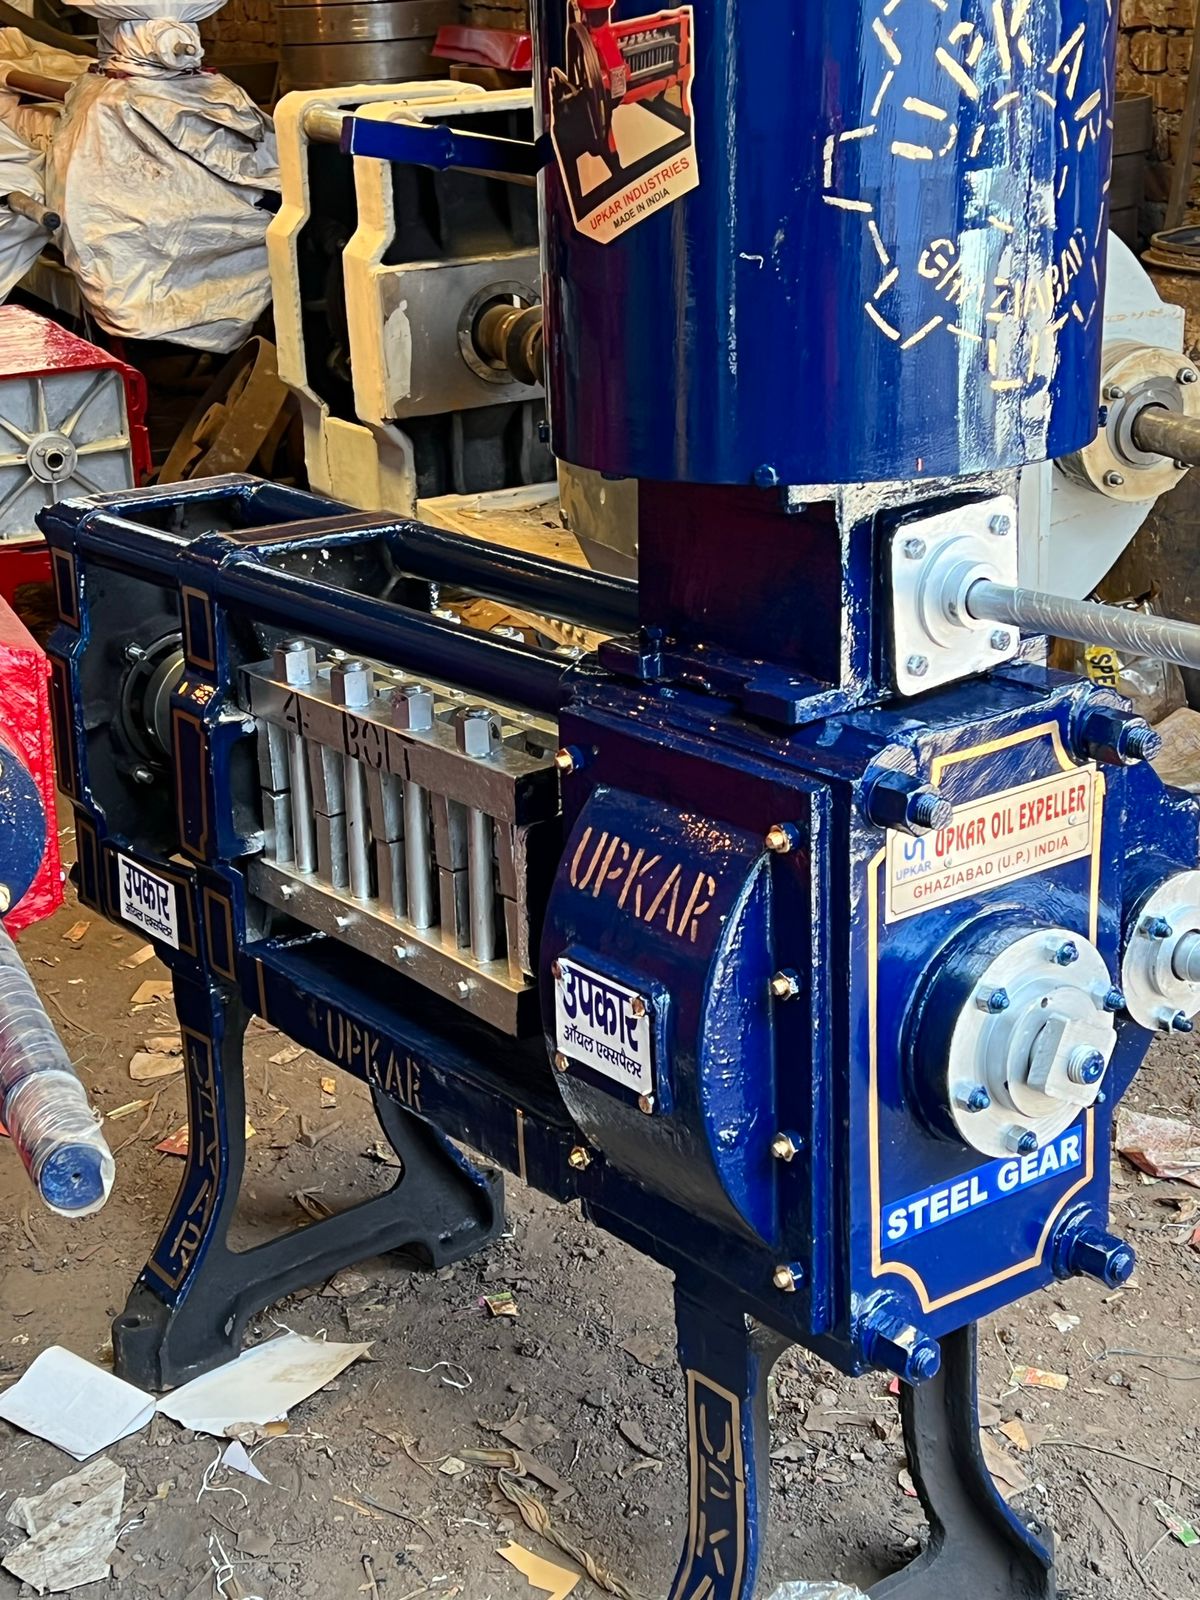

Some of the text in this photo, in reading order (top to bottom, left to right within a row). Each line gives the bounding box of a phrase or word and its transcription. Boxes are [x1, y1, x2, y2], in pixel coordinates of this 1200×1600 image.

[590, 157, 690, 230] UPKAR INDUSTRIES
[613, 187, 670, 229] MADE IN INDIA
[283, 692, 416, 781] 4 BOLT
[935, 783, 1086, 858] UPKAR OIL EXPELLER
[121, 858, 171, 922] उपकार
[570, 826, 716, 944] UPKAR
[895, 859, 932, 882] UPKAR
[913, 835, 1069, 899] GHAZIABAD (U.P.) INDIA
[562, 964, 640, 1053] उपकार
[563, 1022, 594, 1054] ऑयल
[326, 1008, 421, 1112] UPKAR
[886, 1134, 1080, 1241] STEEL GEAR
